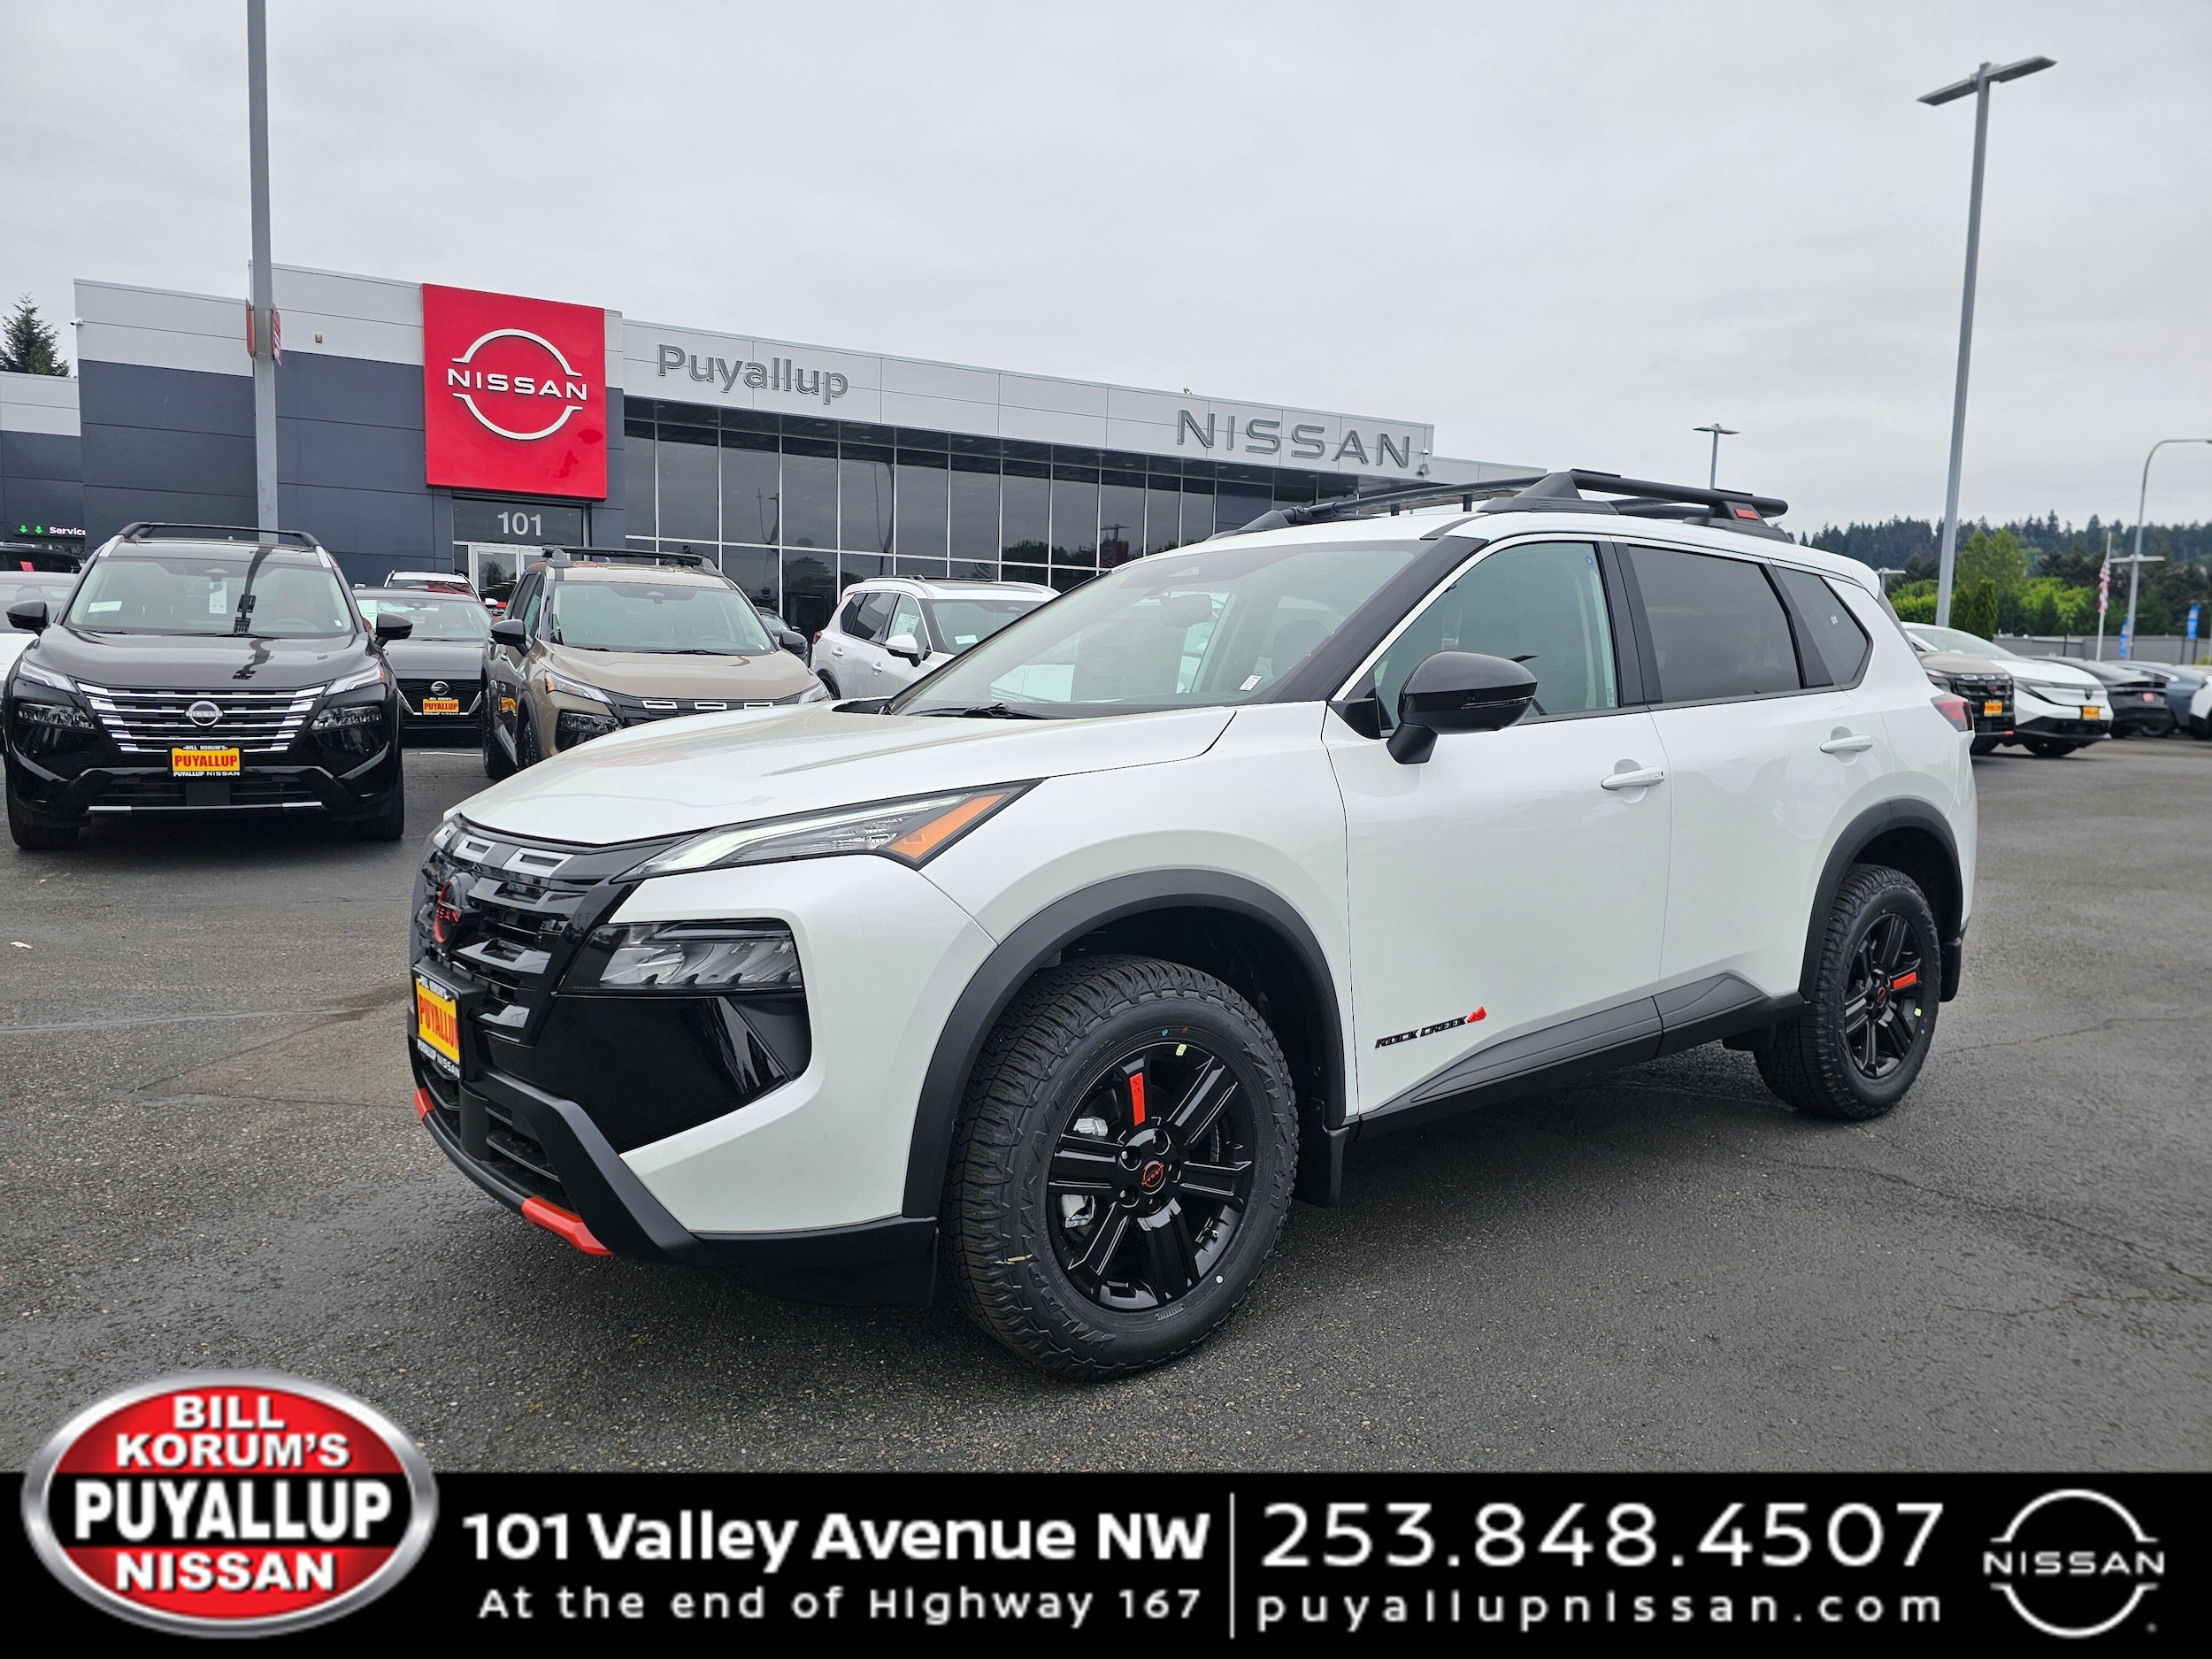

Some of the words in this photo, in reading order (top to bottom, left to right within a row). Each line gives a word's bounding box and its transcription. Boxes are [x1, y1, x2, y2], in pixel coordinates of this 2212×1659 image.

[448, 368, 588, 400] NISSAN
[657, 344, 849, 404] Puyallup
[1178, 410, 1410, 468] NISSAN
[497, 511, 542, 536] 101
[174, 756, 237, 766] PUYALLUP
[1375, 1029, 1418, 1048] ROCK
[1420, 1015, 1467, 1037] CREEK
